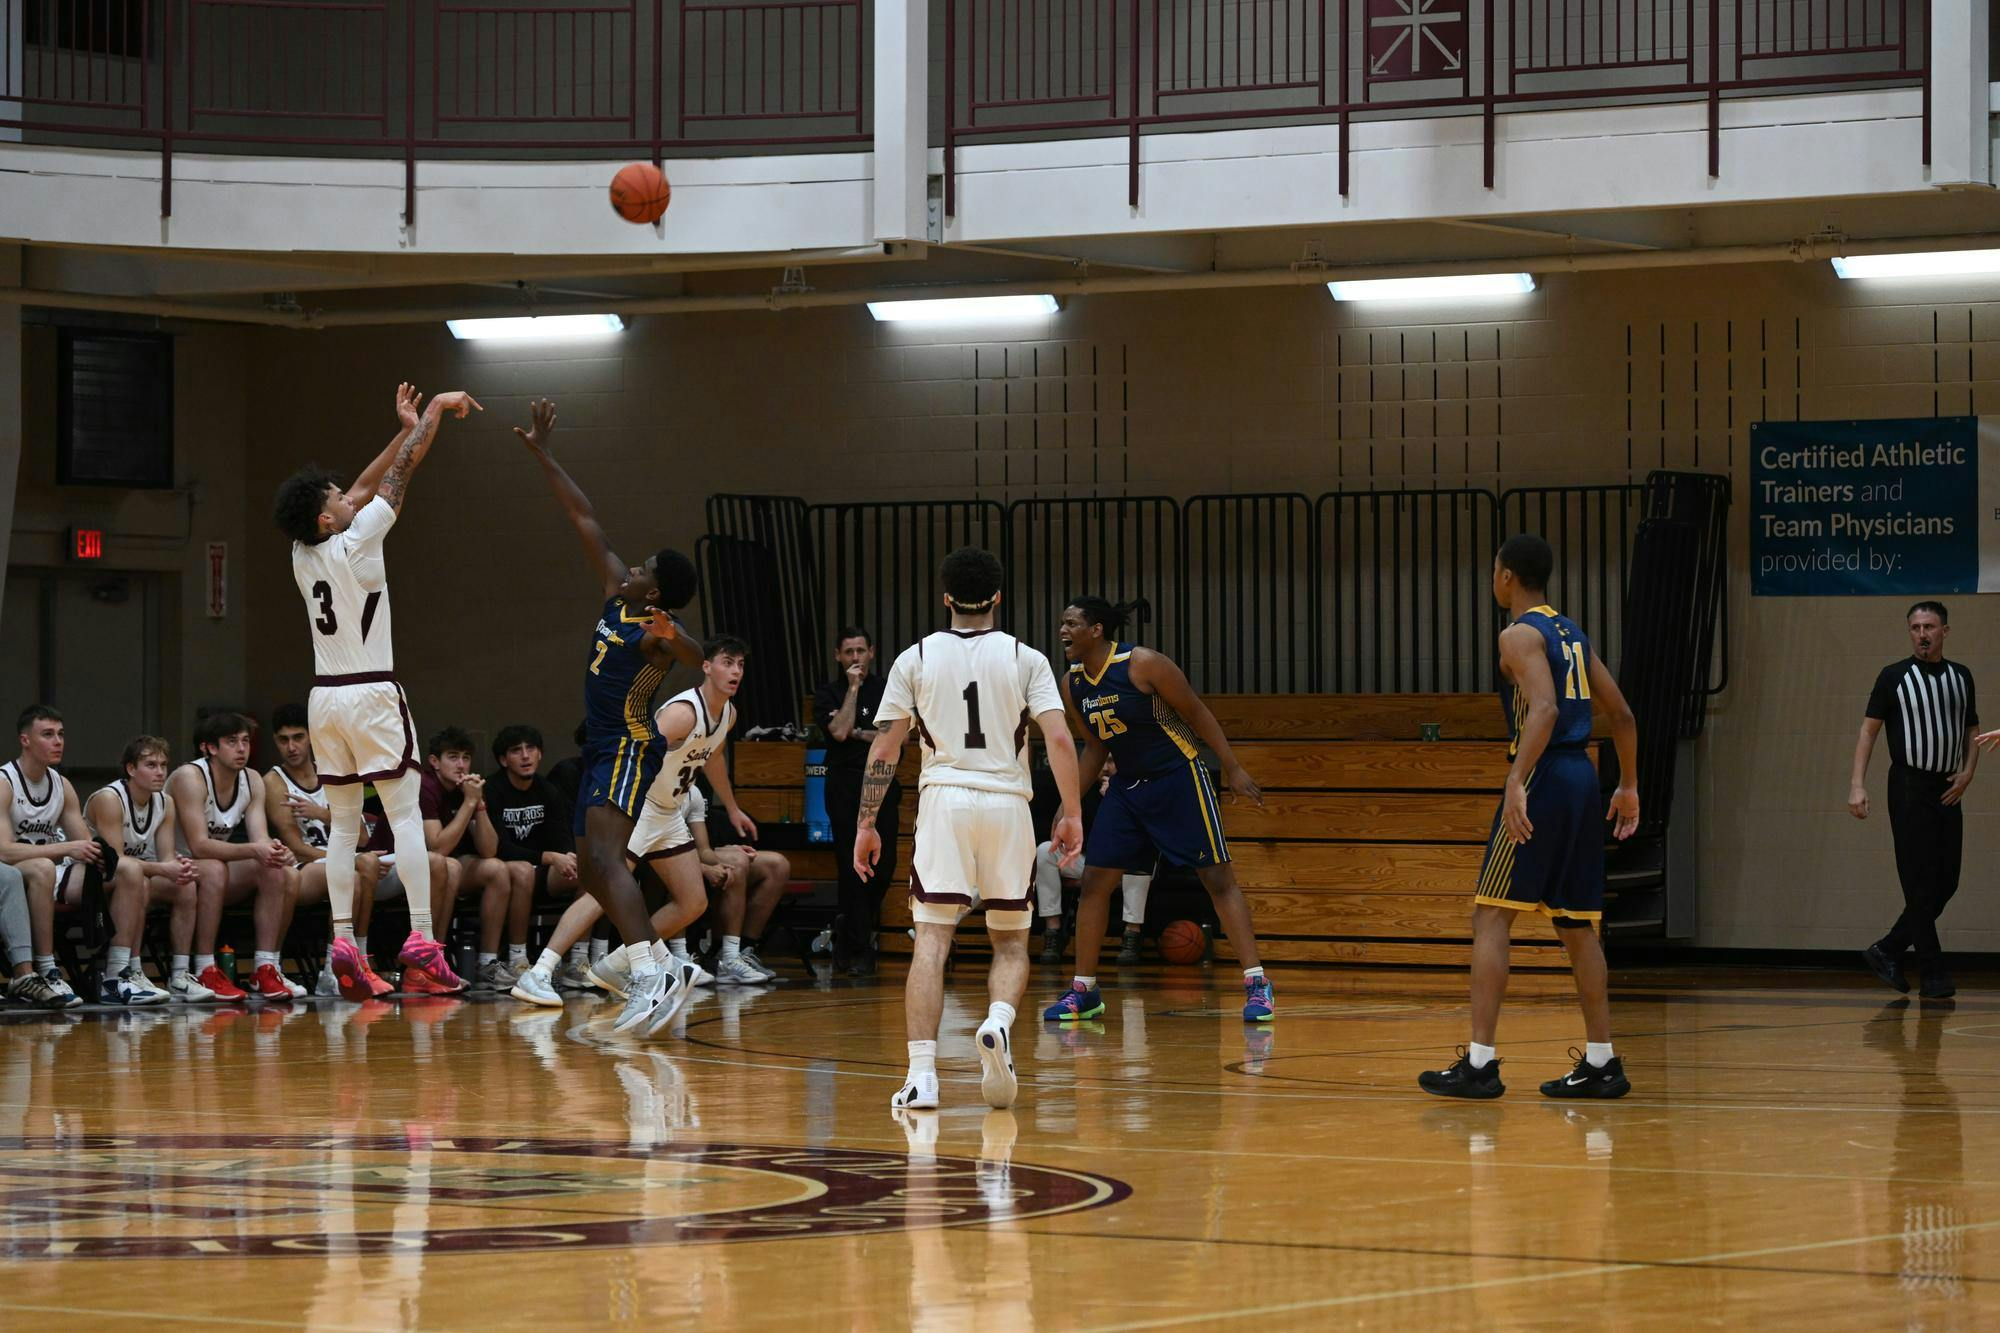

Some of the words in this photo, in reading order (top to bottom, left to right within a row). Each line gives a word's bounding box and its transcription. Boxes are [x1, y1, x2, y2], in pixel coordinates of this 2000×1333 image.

[1760, 443, 1864, 470] Certified
[1871, 441, 1966, 467] Athletic
[1760, 479, 1854, 503] Trainers
[1860, 478, 1903, 502] and
[1760, 514, 1823, 538] Team
[1830, 512, 1954, 540] Physicians
[77, 530, 101, 558] EXIT
[1761, 547, 1860, 577] provided
[1869, 547, 1903, 575] by:
[312, 580, 338, 636] 3
[590, 640, 608, 676] 2
[963, 681, 986, 749] 1
[1088, 708, 1128, 740] 25
